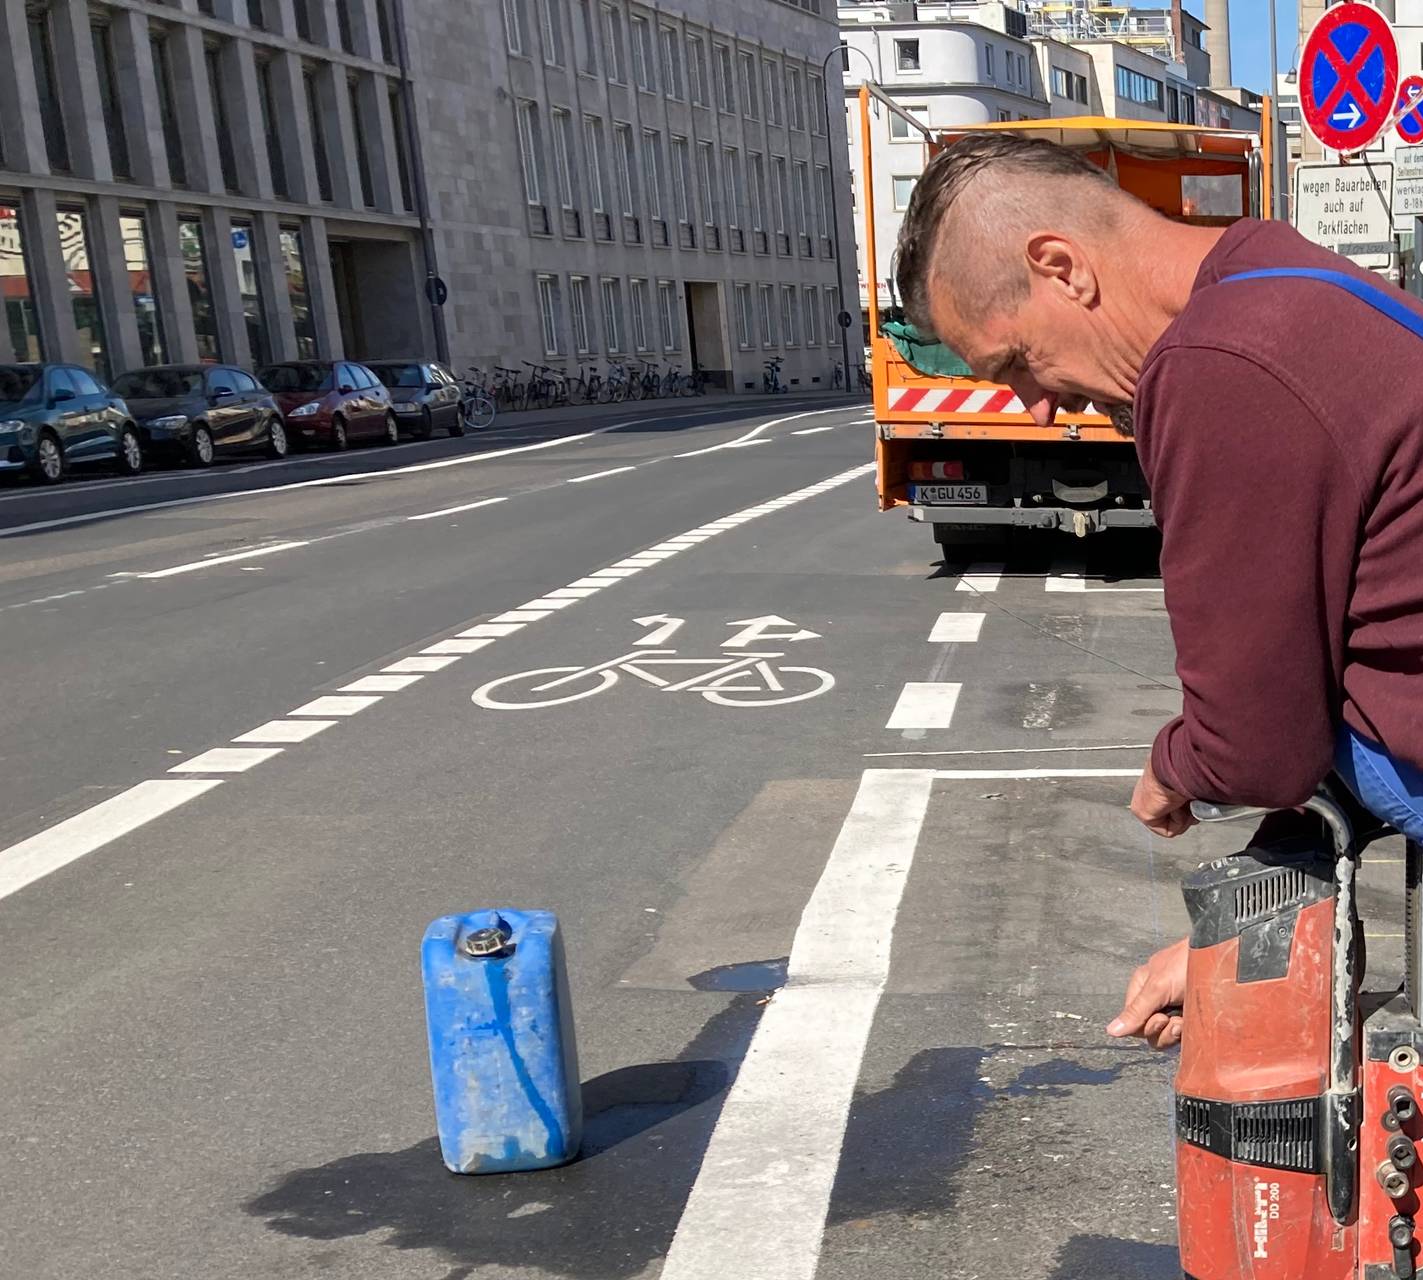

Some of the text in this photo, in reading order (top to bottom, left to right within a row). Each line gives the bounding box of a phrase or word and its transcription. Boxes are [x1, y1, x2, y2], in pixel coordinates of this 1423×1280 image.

[1302, 181, 1330, 196] wegen
[1324, 198, 1364, 213] auch auf
[1317, 220, 1369, 235] Parkflächen
[920, 487, 981, 500] K GU 456
[1269, 1182, 1280, 1219] DD 200
[1253, 1183, 1268, 1258] HILTI
